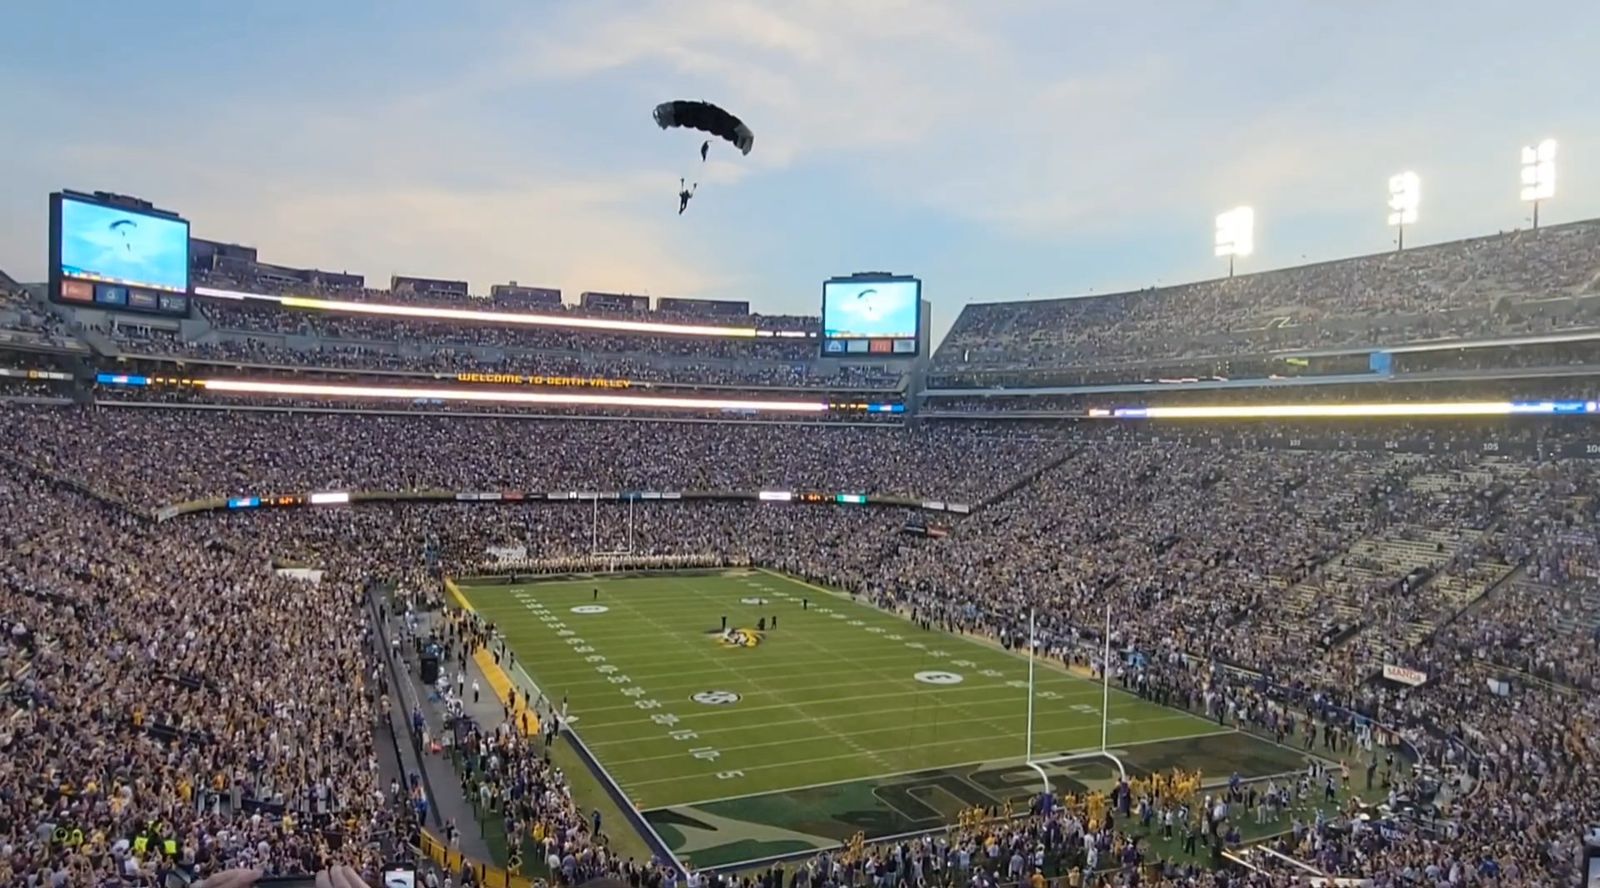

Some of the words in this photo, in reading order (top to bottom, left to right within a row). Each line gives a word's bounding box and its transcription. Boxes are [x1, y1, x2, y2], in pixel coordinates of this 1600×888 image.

[458, 373, 522, 384] WELCOME
[529, 375, 543, 385] TO
[547, 376, 585, 386] DEATH
[590, 378, 631, 388] VALLEY
[1482, 442, 1499, 451] 105
